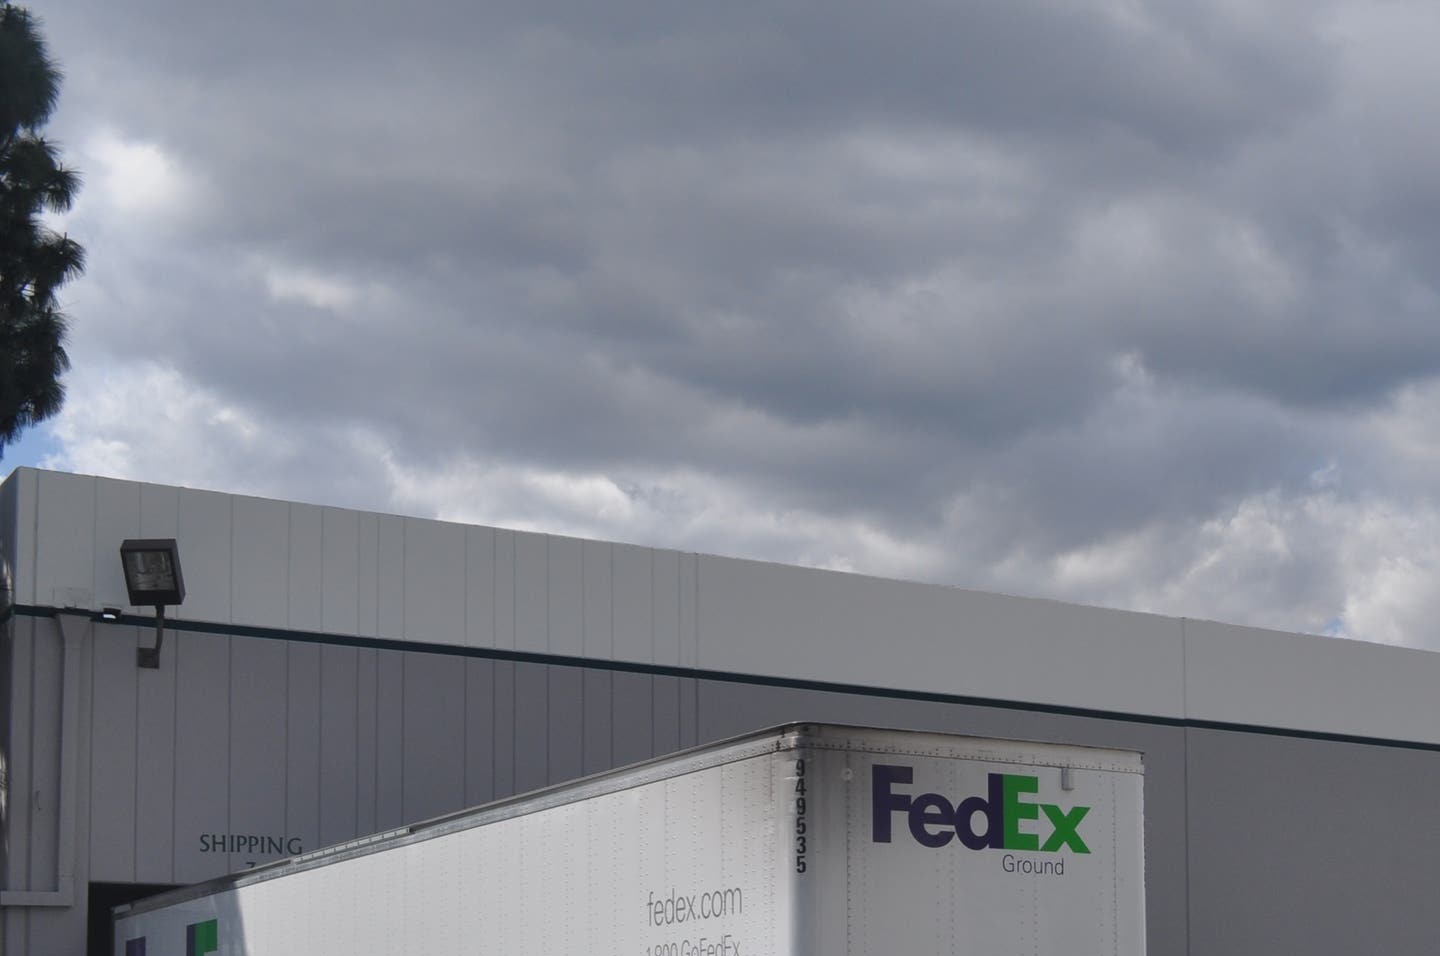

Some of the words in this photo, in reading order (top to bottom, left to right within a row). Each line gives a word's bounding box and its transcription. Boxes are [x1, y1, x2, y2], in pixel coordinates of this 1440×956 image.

[795, 758, 807, 873] 949535
[872, 764, 1091, 854] FedEx
[199, 834, 303, 855] SHIPPING
[1002, 854, 1064, 875] Ground
[646, 887, 742, 926] fedex.com
